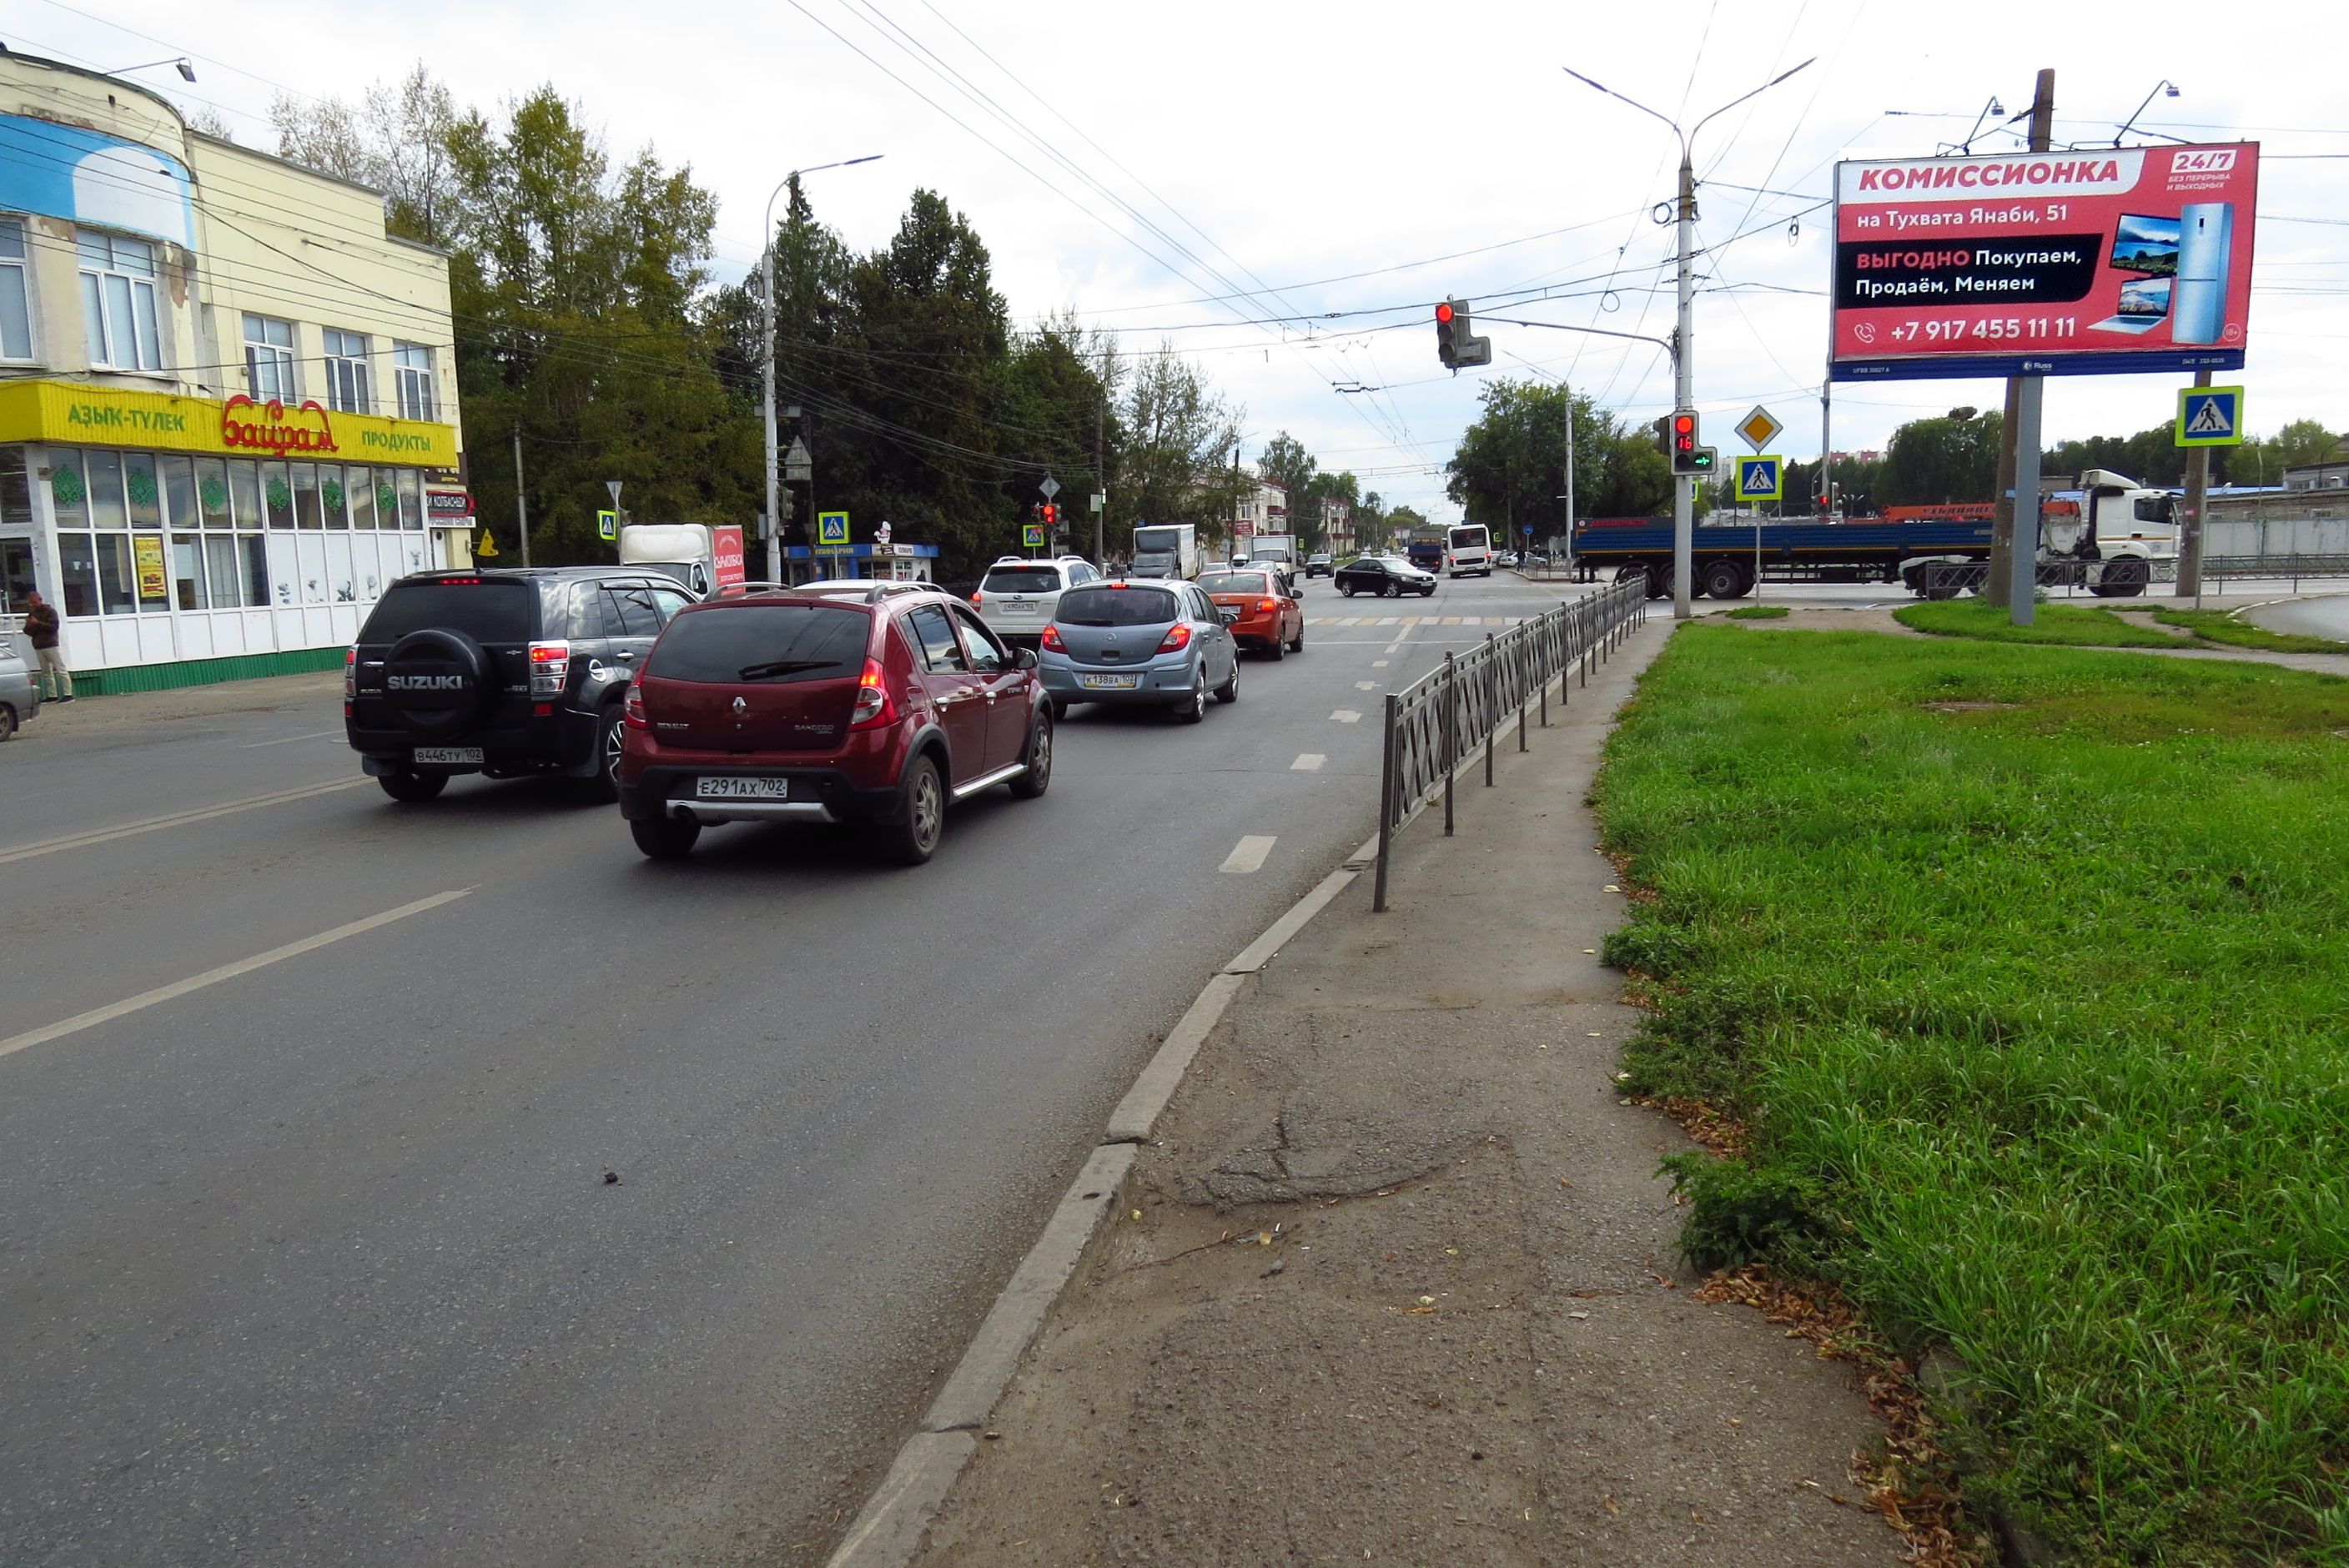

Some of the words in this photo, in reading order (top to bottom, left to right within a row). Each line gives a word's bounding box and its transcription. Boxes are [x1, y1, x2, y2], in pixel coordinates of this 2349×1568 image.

[2175, 153, 2231, 170] 24/7
[1859, 159, 2119, 191] КОМИССИОНКА
[2186, 173, 2231, 182] ПЕРЕРЫВА
[2175, 182, 2225, 191] ВЫХОДНЫХ
[1857, 214, 1880, 228] на
[1885, 210, 1964, 231] Тухвата
[1969, 206, 2041, 225] Янаби,
[2046, 204, 2069, 222] 51
[1856, 250, 1970, 270] ВЫГОДНО
[1974, 249, 2082, 269] Покупаем,
[1855, 278, 1949, 299] Продаём,
[1954, 276, 2035, 293] Меняем
[1891, 320, 1919, 342] +7
[1925, 319, 1966, 340] 917
[1971, 319, 2020, 339] 455
[2027, 318, 2049, 339] 11
[2055, 316, 2076, 338] 11
[361, 430, 431, 451] ПРОДУКТЫ
[1679, 436, 1692, 450] 16
[387, 676, 463, 690] SUZUKI
[1086, 675, 1119, 684] К138ВА
[417, 750, 460, 761] В446ТУ
[701, 779, 757, 795] Е291АХ
[760, 779, 783, 792] 702
